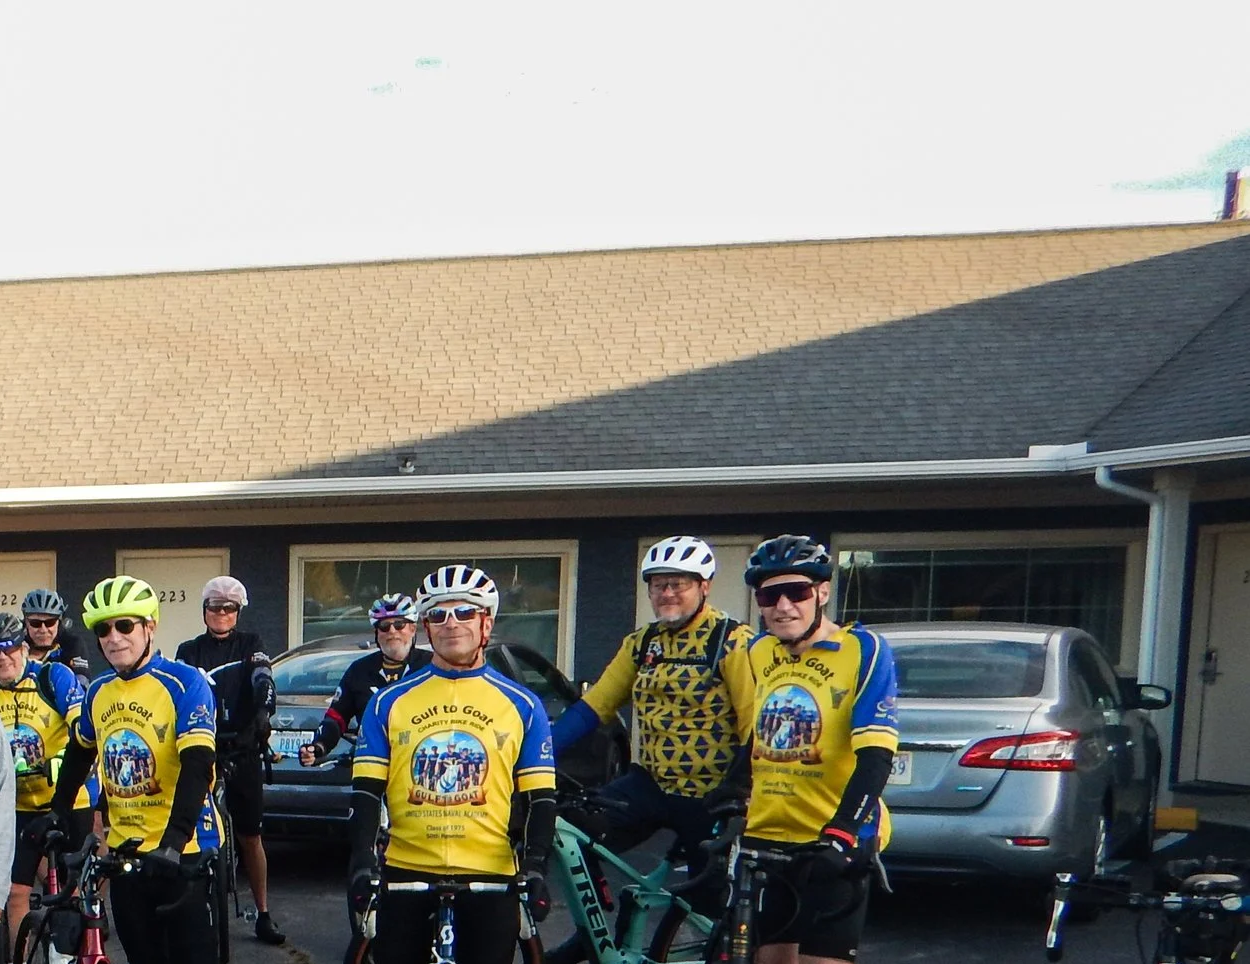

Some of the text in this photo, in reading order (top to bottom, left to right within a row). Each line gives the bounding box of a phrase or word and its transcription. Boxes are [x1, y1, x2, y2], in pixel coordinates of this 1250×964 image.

[159, 590, 187, 603] 223
[805, 657, 835, 681] Goat
[129, 701, 153, 721] Goat
[411, 704, 494, 726] Gulf to Goat
[418, 720, 449, 733] CHARITY
[469, 721, 486, 732] RIDE
[415, 790, 439, 804] GULF
[454, 790, 479, 802] GOAT
[570, 856, 613, 953] TREK
